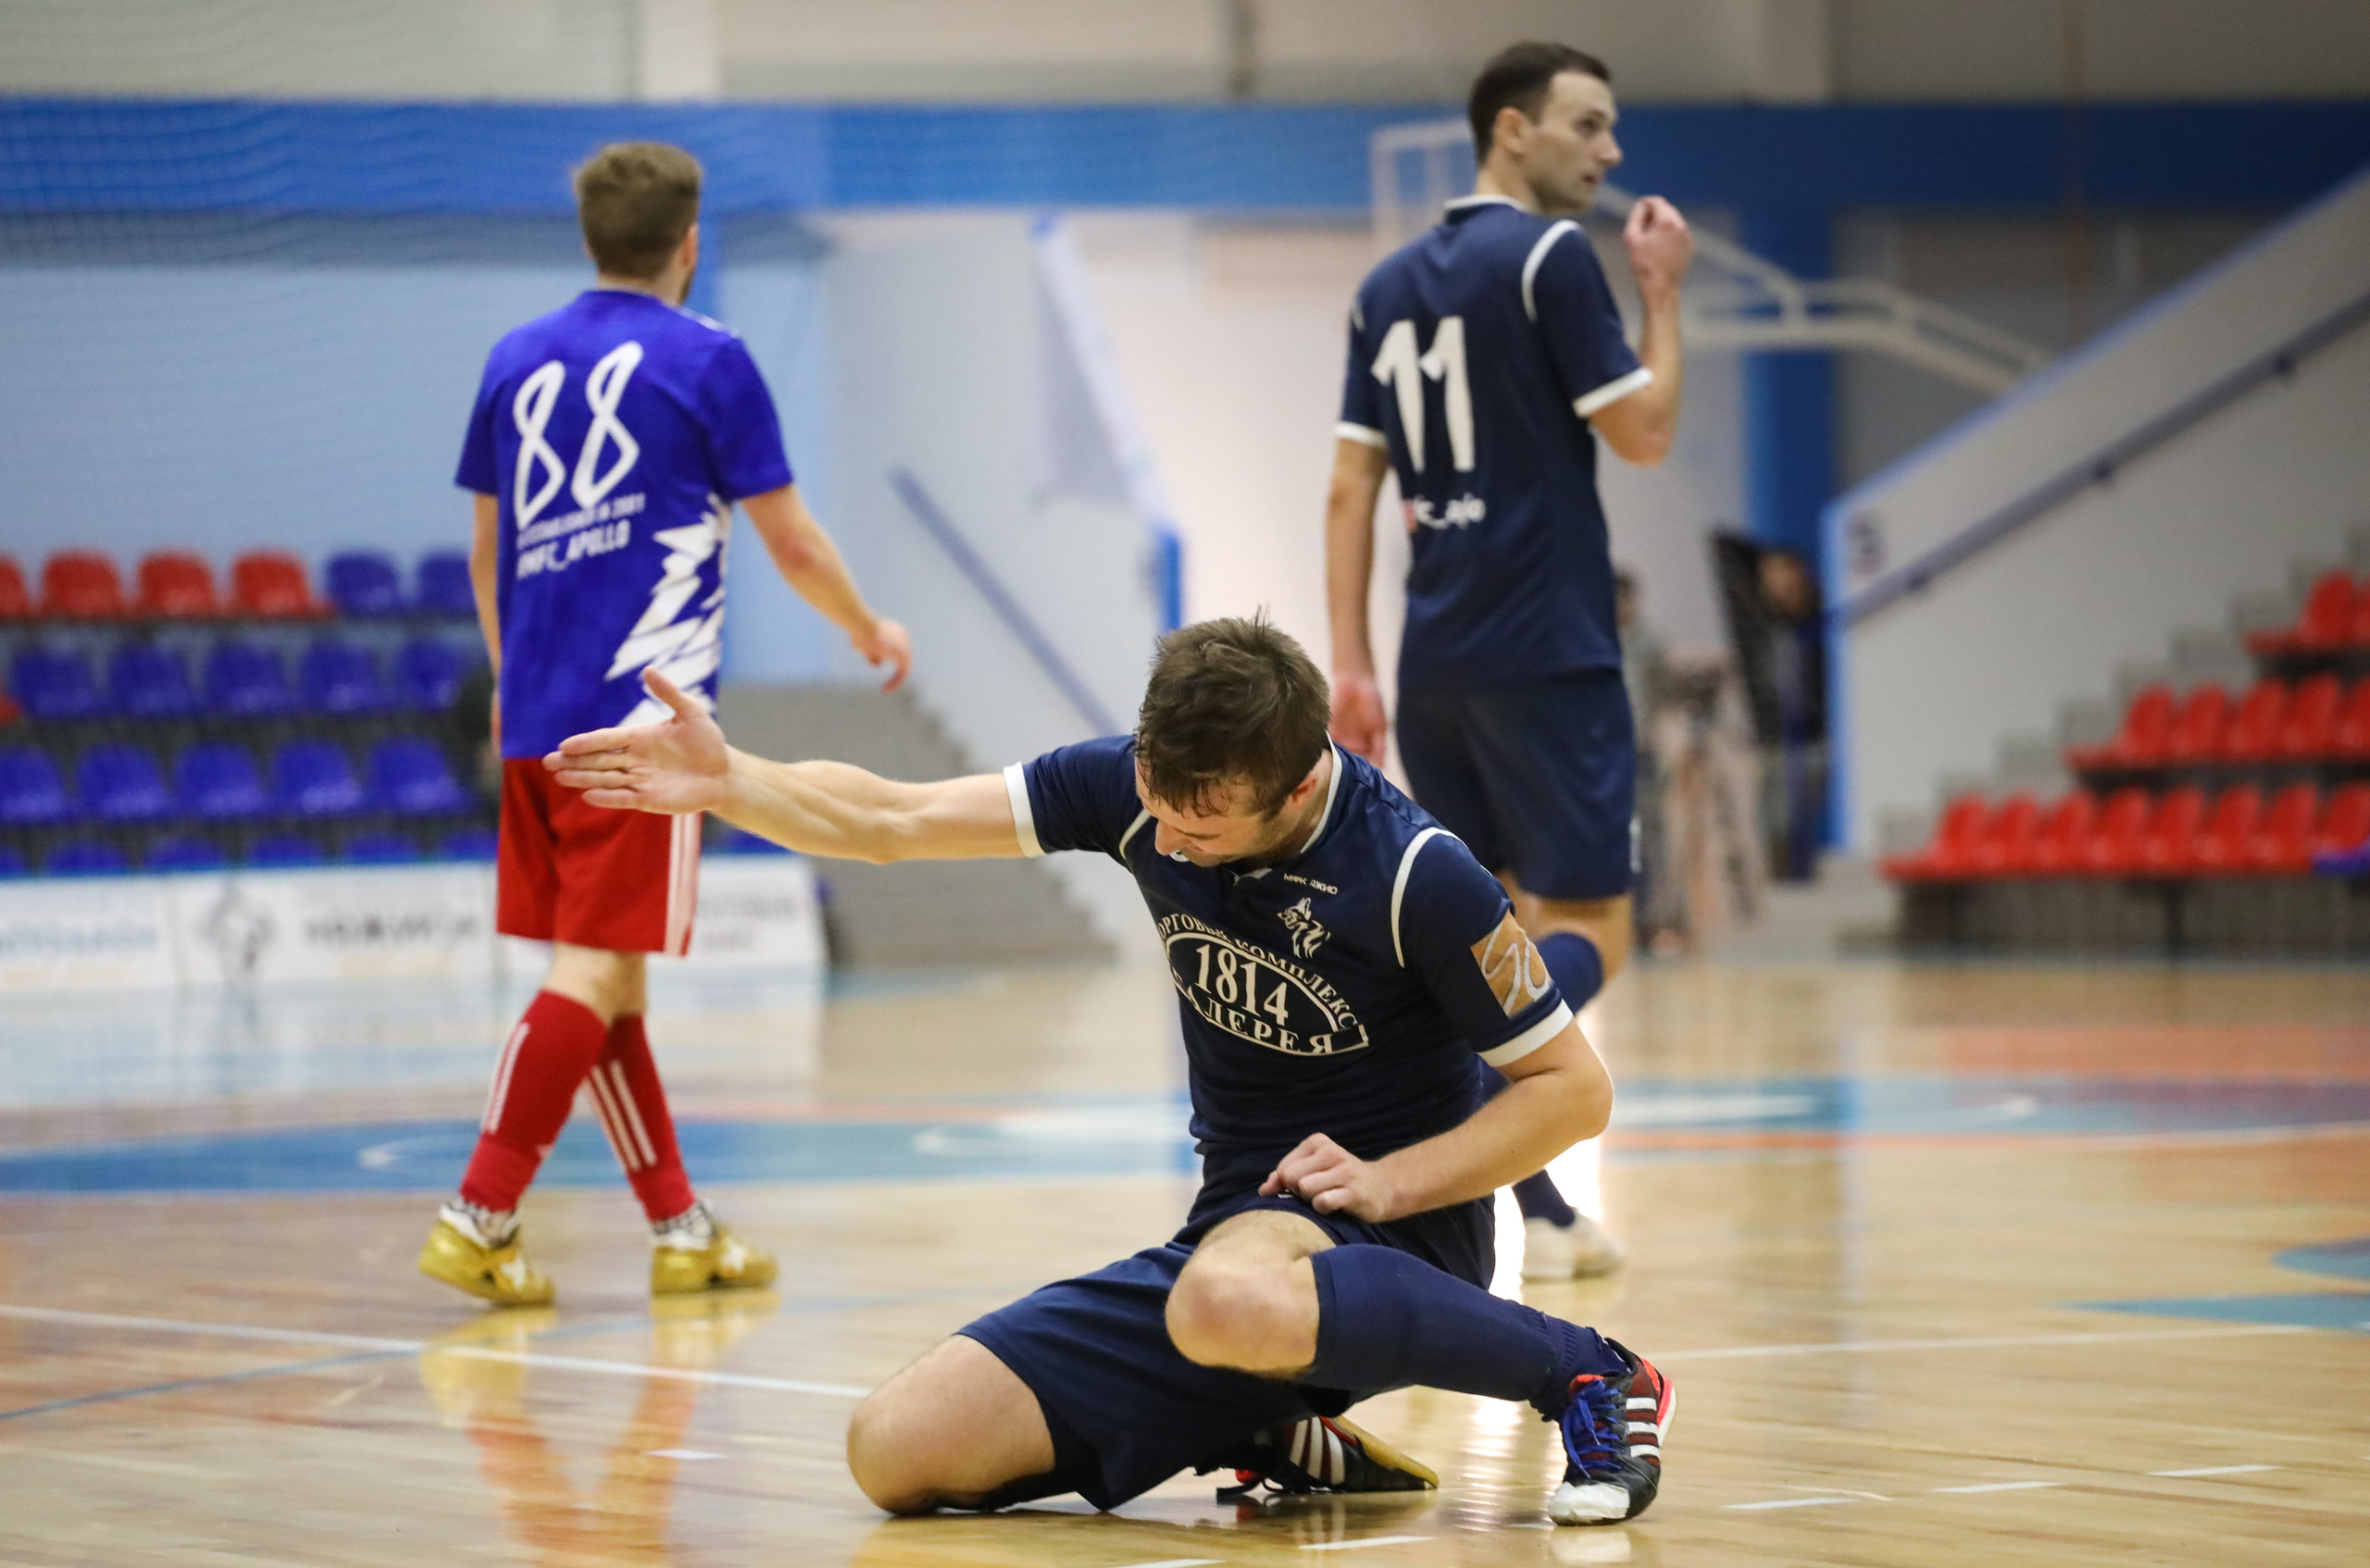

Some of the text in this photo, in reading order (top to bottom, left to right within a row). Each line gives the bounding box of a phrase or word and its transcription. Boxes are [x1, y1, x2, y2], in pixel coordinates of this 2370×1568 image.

[513, 340, 642, 530] 88
[1371, 316, 1475, 472] 11
[1195, 943, 1289, 1027] 1814
[1235, 938, 1358, 1028] КОМПЛЕКС
